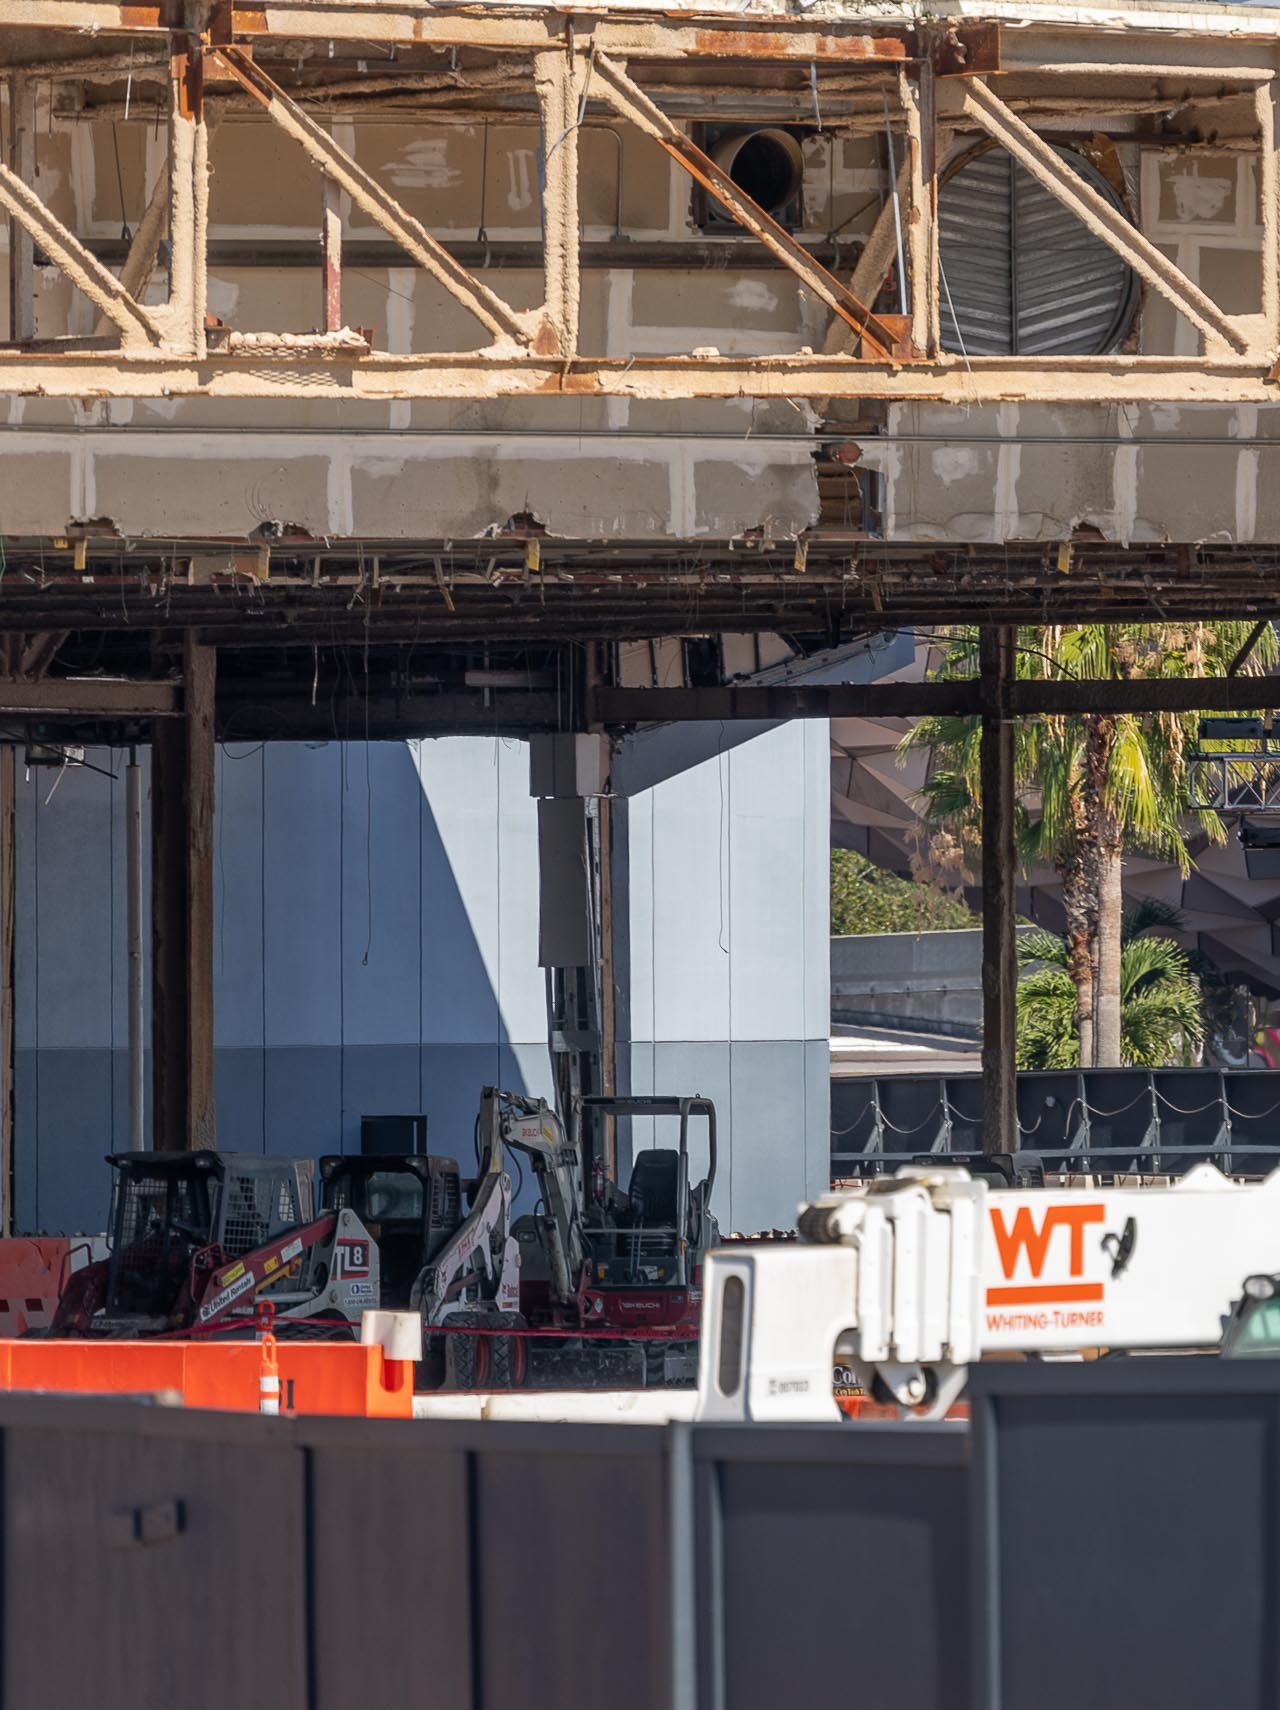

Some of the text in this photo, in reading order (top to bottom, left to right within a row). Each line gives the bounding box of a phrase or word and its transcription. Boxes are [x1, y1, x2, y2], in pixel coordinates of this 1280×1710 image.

[989, 1204, 1105, 1280] WT
[210, 1277, 253, 1313] United Rentals
[986, 1310, 1104, 1332] WHITING-TURNER
